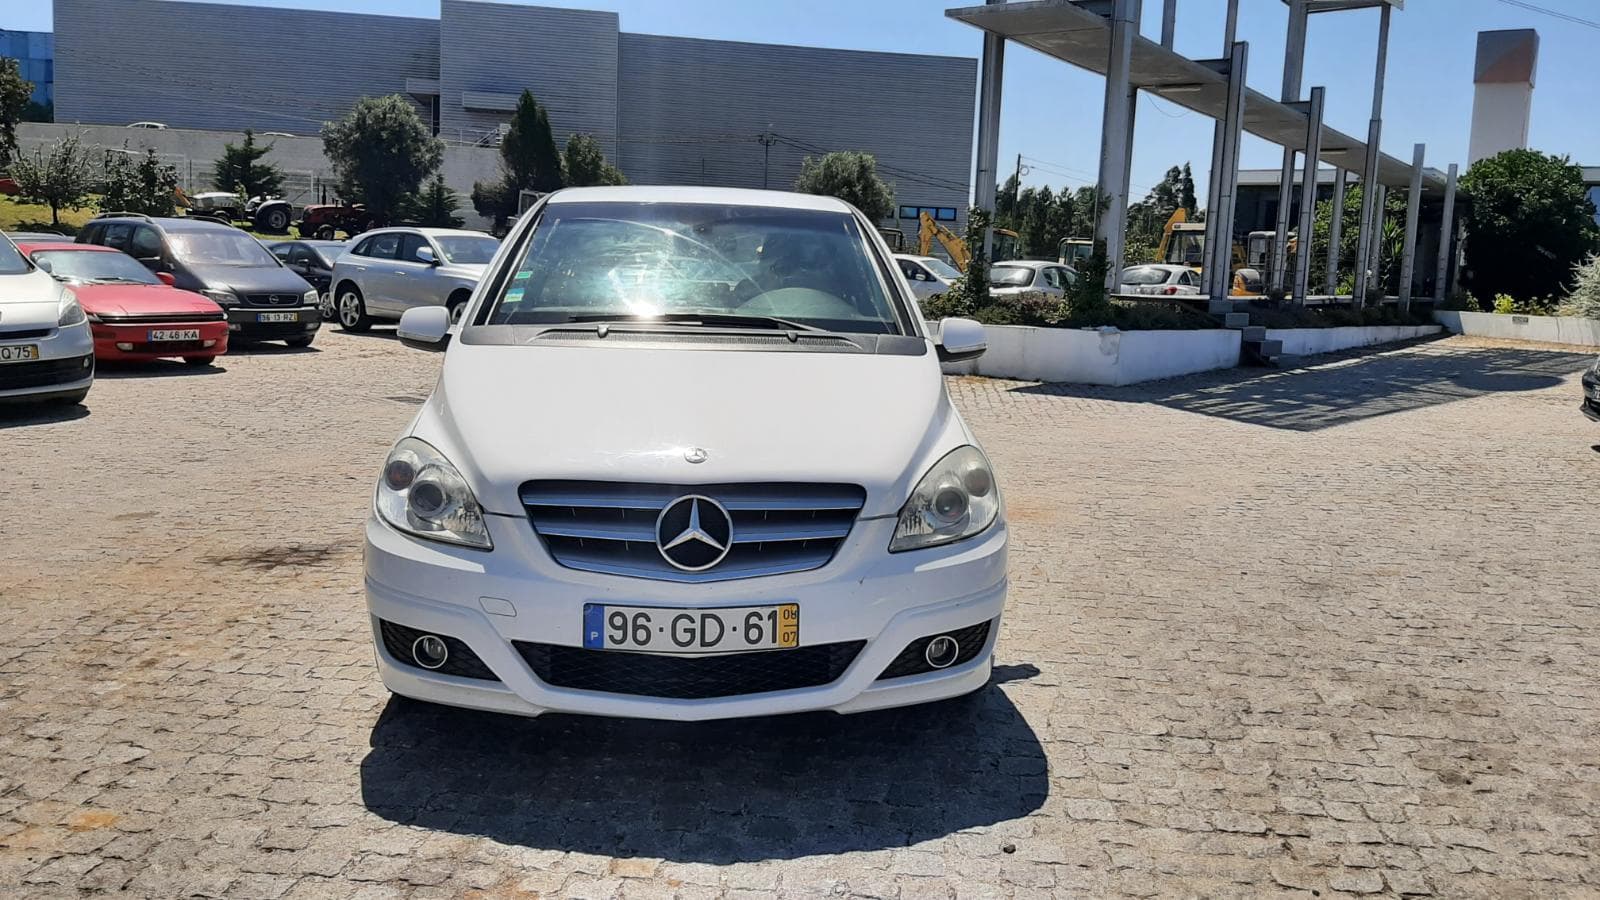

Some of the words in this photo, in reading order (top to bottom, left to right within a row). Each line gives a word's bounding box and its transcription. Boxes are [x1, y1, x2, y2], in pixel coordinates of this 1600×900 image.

[183, 330, 198, 339] KA
[590, 631, 599, 641] P
[782, 631, 797, 643] 07
